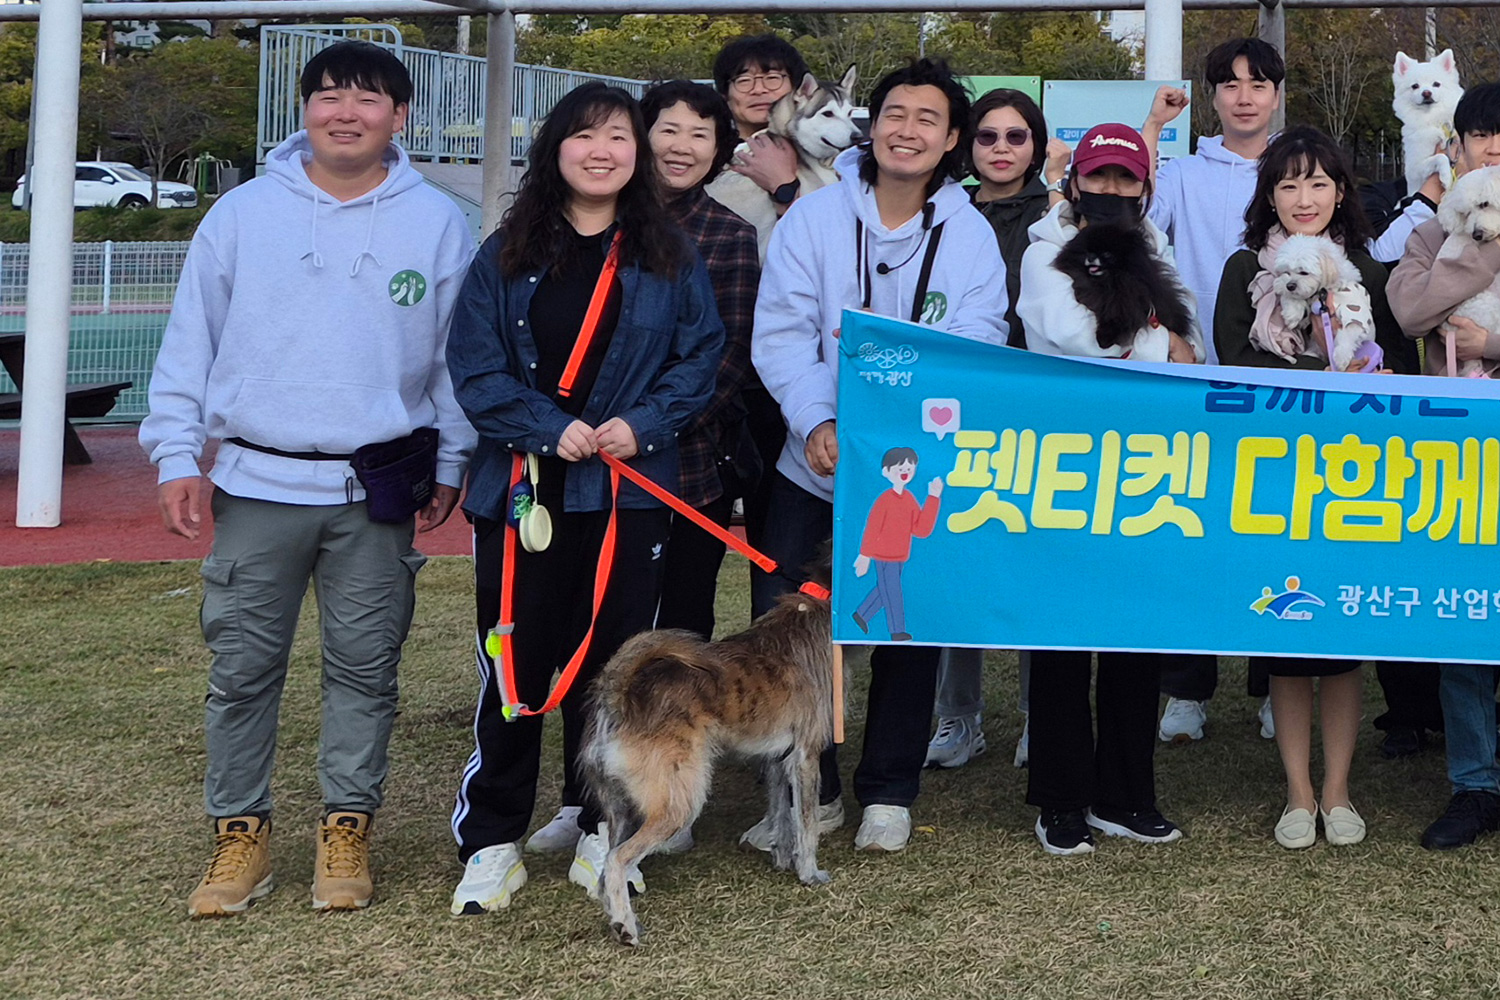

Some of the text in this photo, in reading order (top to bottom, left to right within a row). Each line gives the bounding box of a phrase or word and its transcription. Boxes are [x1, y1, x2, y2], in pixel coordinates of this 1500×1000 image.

[946, 429, 1211, 537] 펫티켓
[1230, 433, 1500, 545] 다함께
[1337, 585, 1421, 617] 광산구
